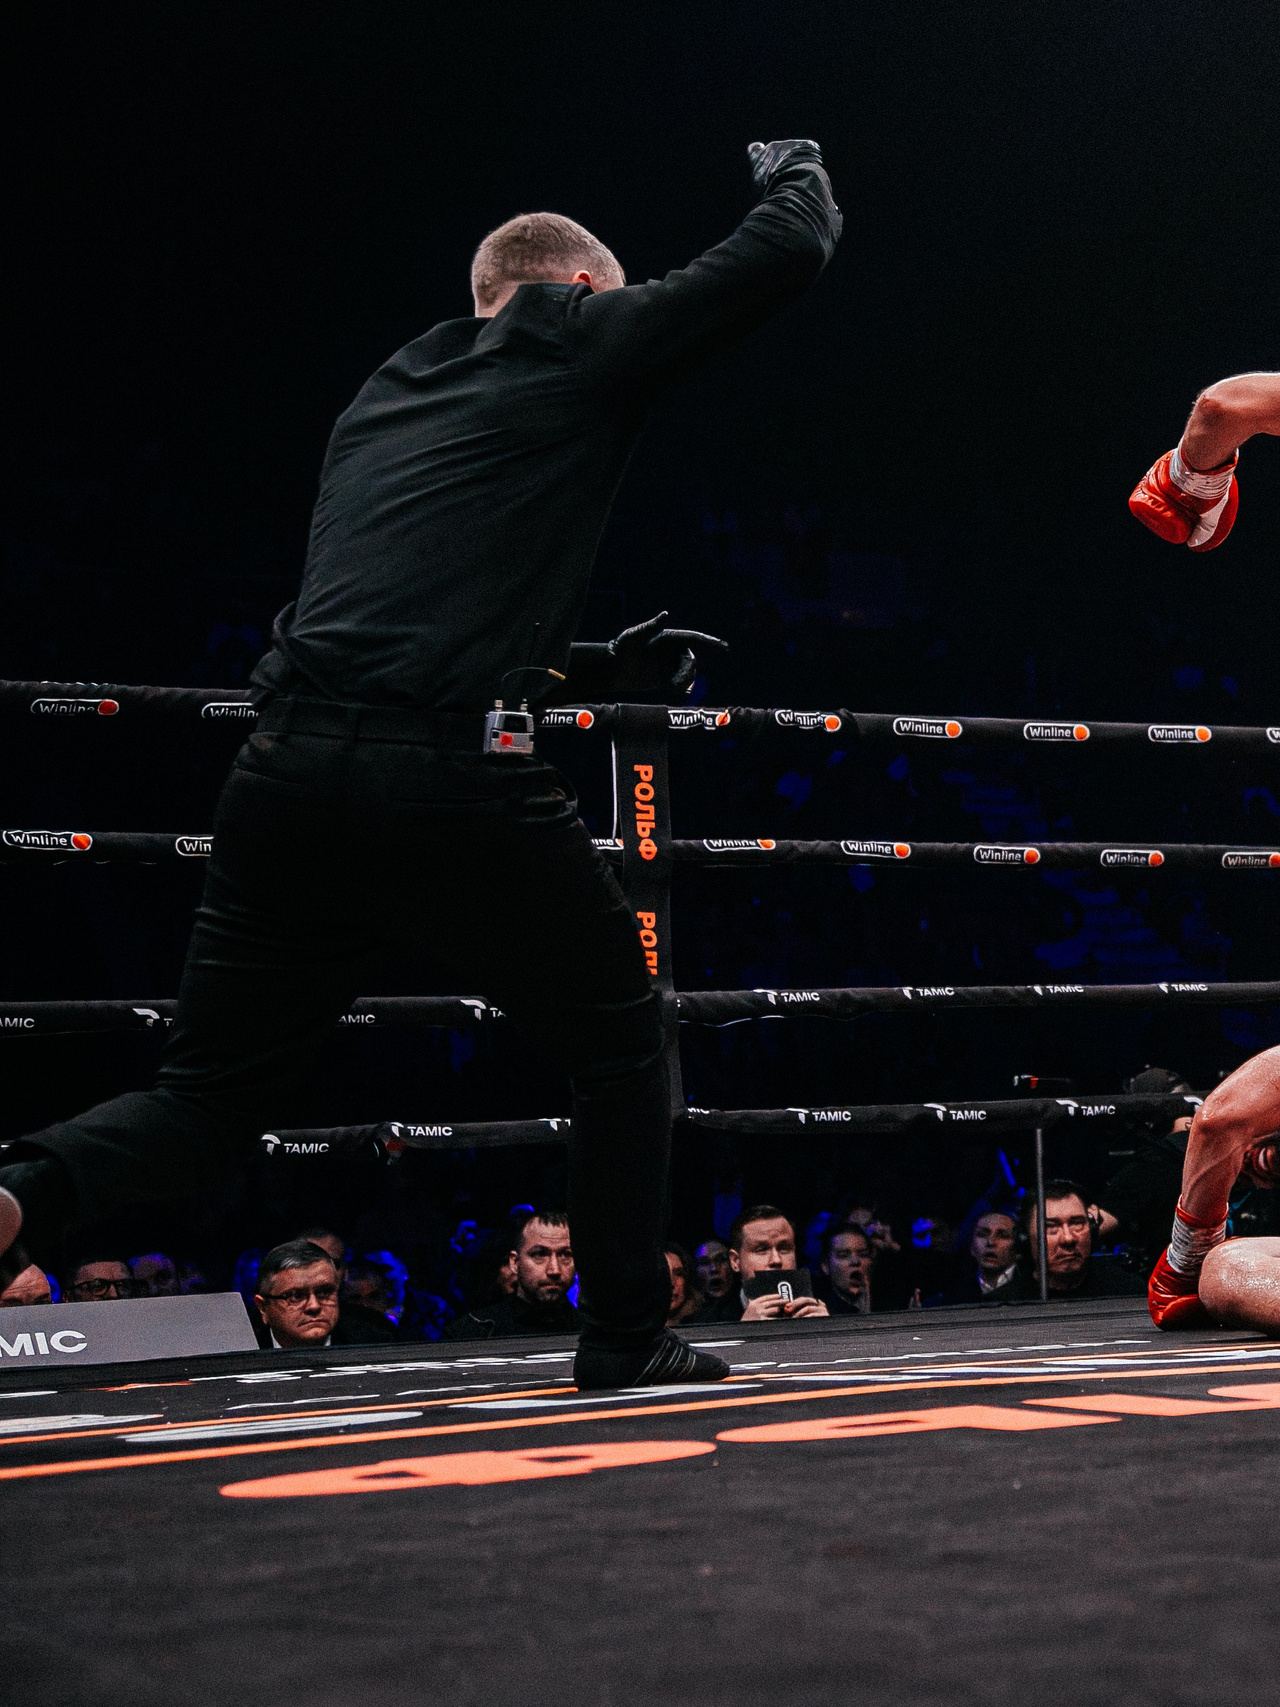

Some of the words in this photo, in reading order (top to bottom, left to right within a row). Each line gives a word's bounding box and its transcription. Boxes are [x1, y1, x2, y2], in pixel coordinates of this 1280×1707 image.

[210, 707, 259, 718] Winlin
[541, 715, 574, 725] nline
[900, 721, 943, 735] Winline
[1028, 726, 1071, 739] Winline
[1153, 728, 1194, 740] Winline
[634, 764, 658, 860] РОЛЬФ
[11, 833, 68, 846] Winline
[848, 841, 892, 855] Winline
[979, 850, 1022, 862] Winline
[1105, 853, 1146, 865] Winline
[1227, 855, 1268, 867] Winline
[636, 911, 658, 976] РОЛ
[916, 987, 954, 998] TAMIC
[1046, 985, 1084, 994] TAMIC
[1171, 983, 1208, 993] TAMIC
[781, 992, 820, 1003] TAMIC
[0, 1017, 35, 1029] MIC
[338, 1014, 376, 1024] AMIC
[812, 1111, 852, 1122] TAMIC
[949, 1110, 987, 1122] TAMIC
[1081, 1105, 1116, 1117] TAMIC
[407, 1126, 453, 1137] TAMIC
[284, 1143, 329, 1154] TAMIC
[0, 1329, 88, 1357] MIC
